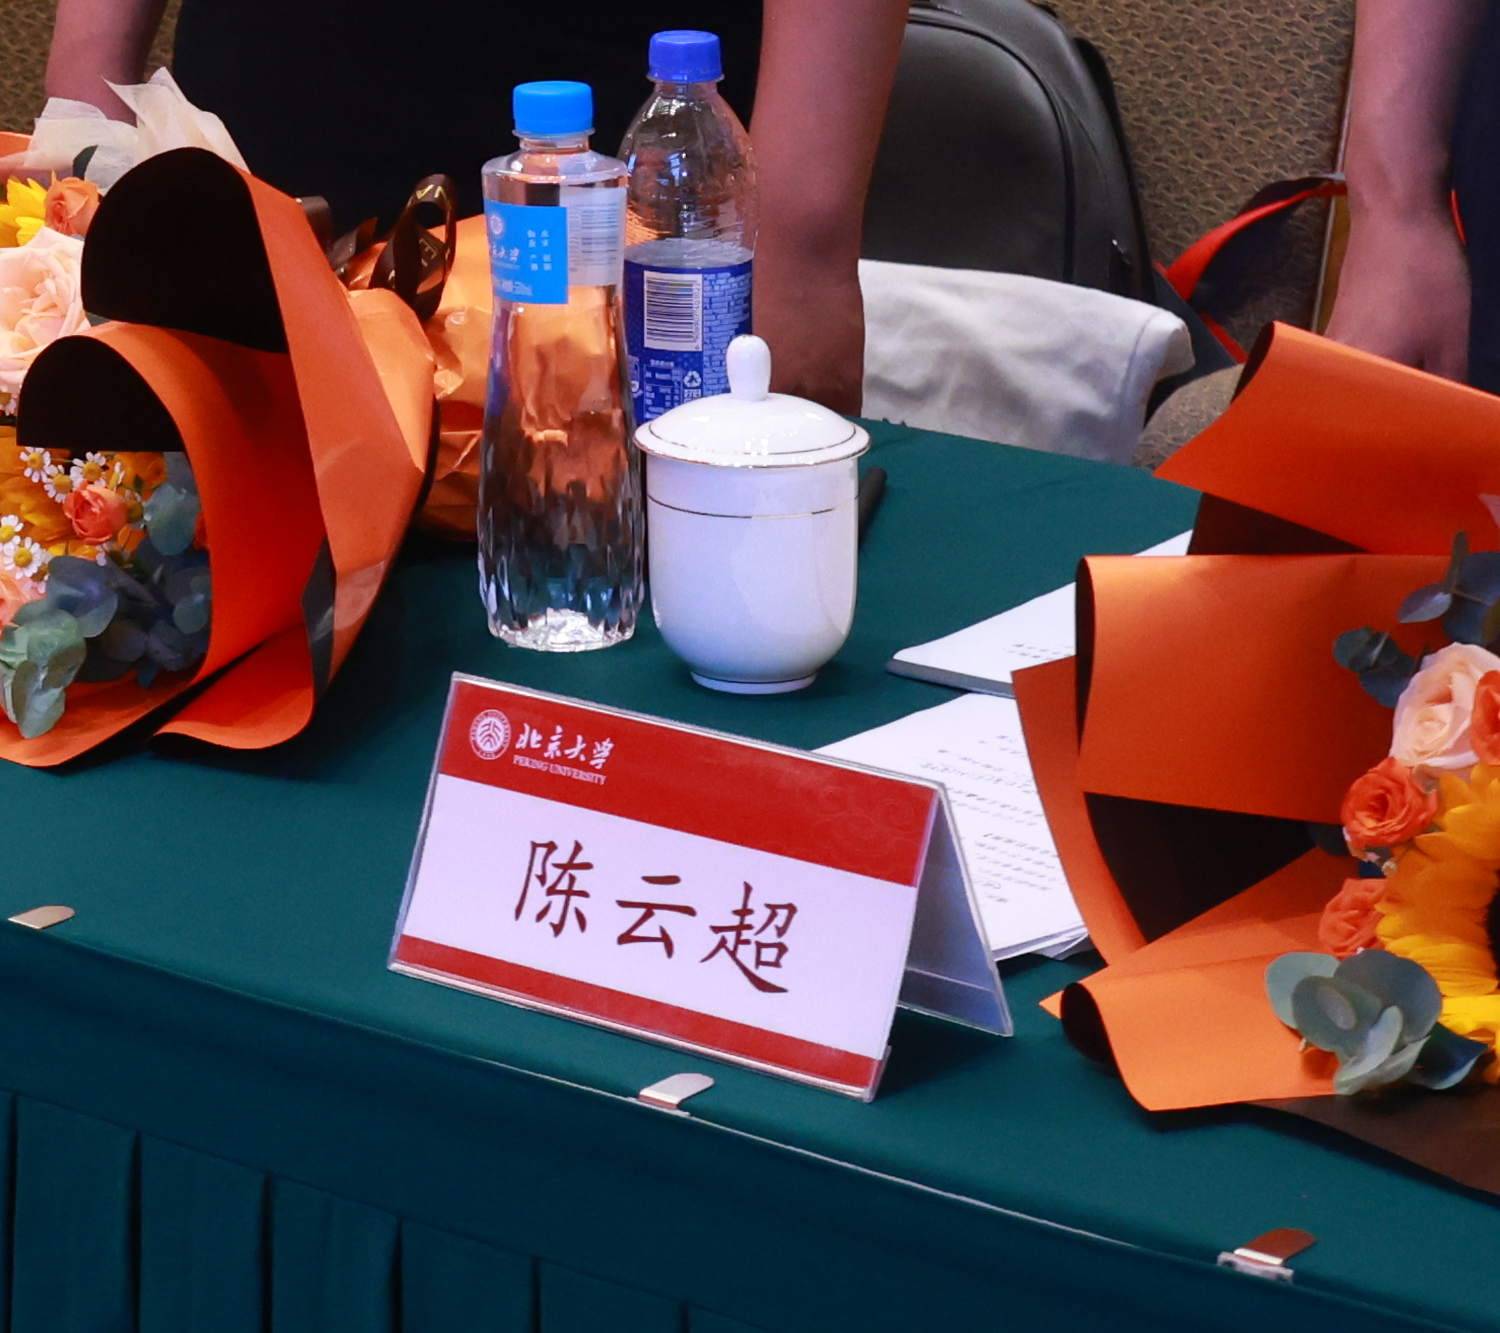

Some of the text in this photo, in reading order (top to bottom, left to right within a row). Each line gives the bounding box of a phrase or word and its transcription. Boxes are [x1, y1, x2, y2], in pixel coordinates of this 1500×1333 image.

[512, 754, 608, 786] PEKING UNIVERSITY
[514, 722, 615, 770] 北京大学
[513, 838, 799, 994] 陈云超
